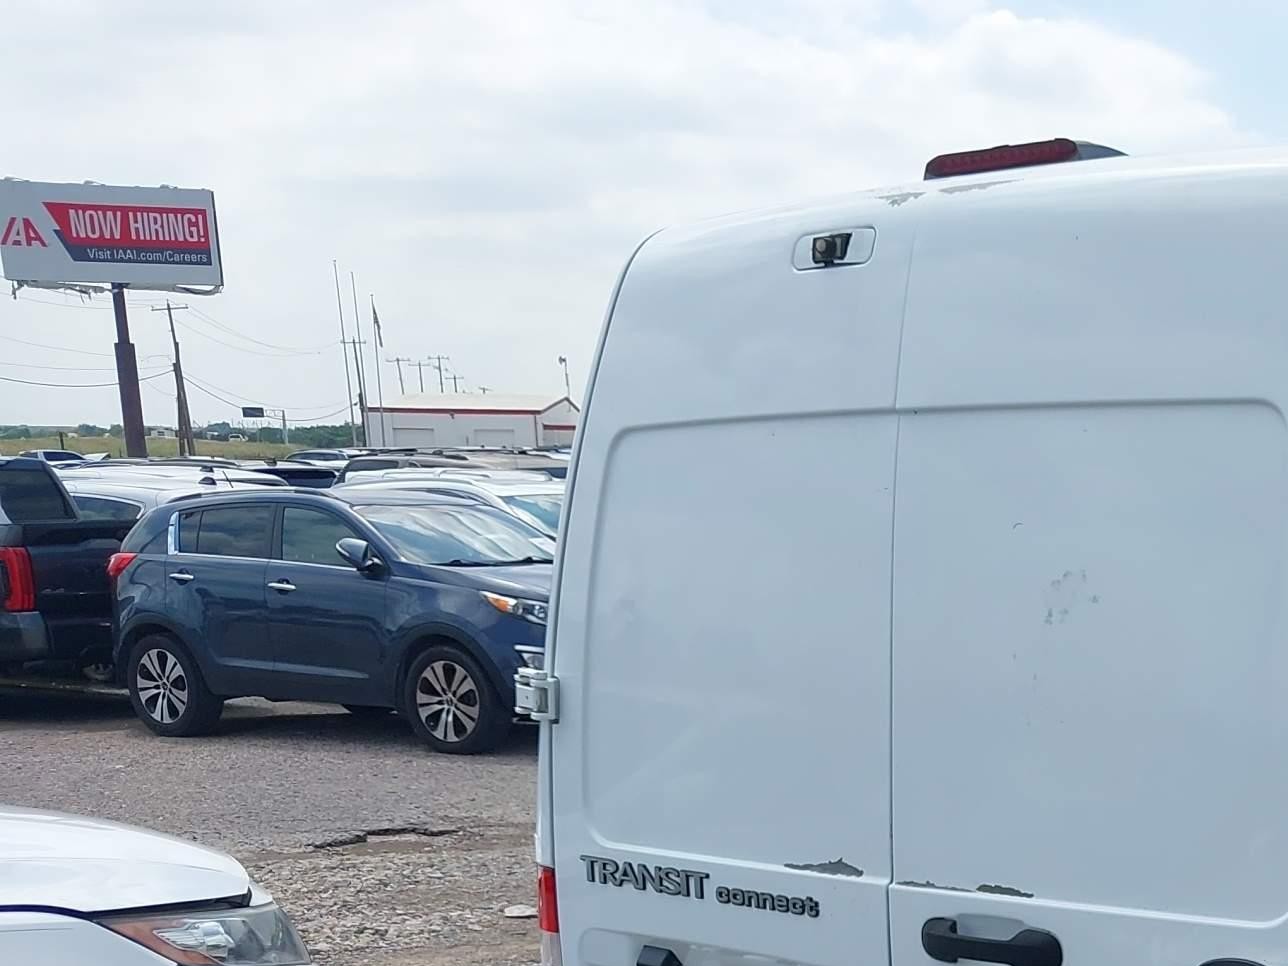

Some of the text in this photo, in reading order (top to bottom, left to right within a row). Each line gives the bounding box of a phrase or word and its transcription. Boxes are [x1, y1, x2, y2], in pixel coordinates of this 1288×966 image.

[68, 208, 206, 242] NOW HIRING!
[87, 248, 208, 263] Visit IAAI.com/Careers
[580, 854, 820, 918] TRANSIT connect
